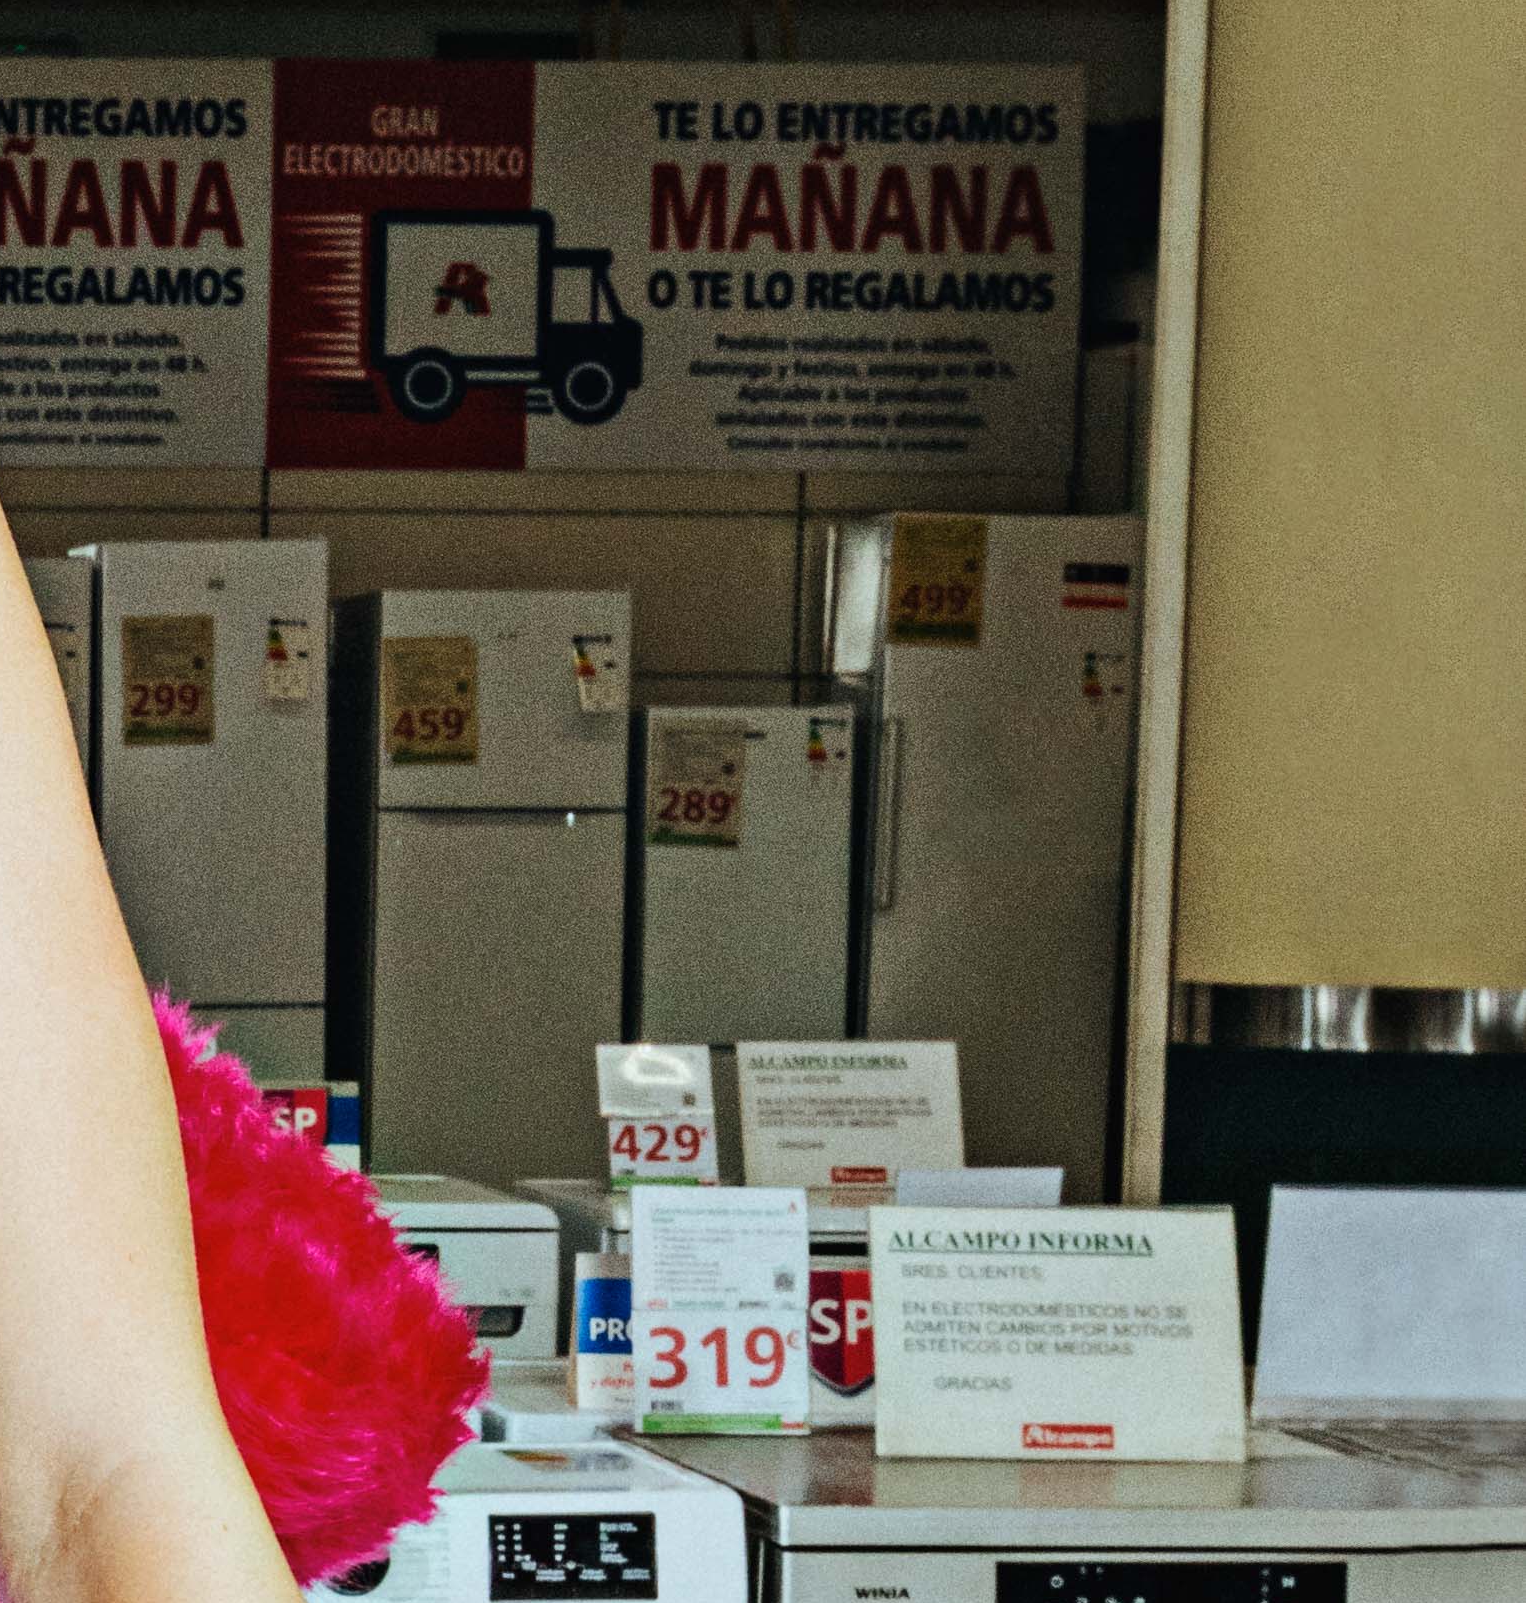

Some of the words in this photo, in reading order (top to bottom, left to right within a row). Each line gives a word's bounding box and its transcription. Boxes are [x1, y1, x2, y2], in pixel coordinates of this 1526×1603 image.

[130, 683, 203, 718] 299
[393, 706, 469, 742] 459
[889, 1231, 1019, 1249] ALCAMPO
[1029, 1233, 1152, 1251] INFORMA
[809, 1298, 873, 1345] SP
[649, 1325, 800, 1390] 319€
[854, 1586, 911, 1601] WINIA
